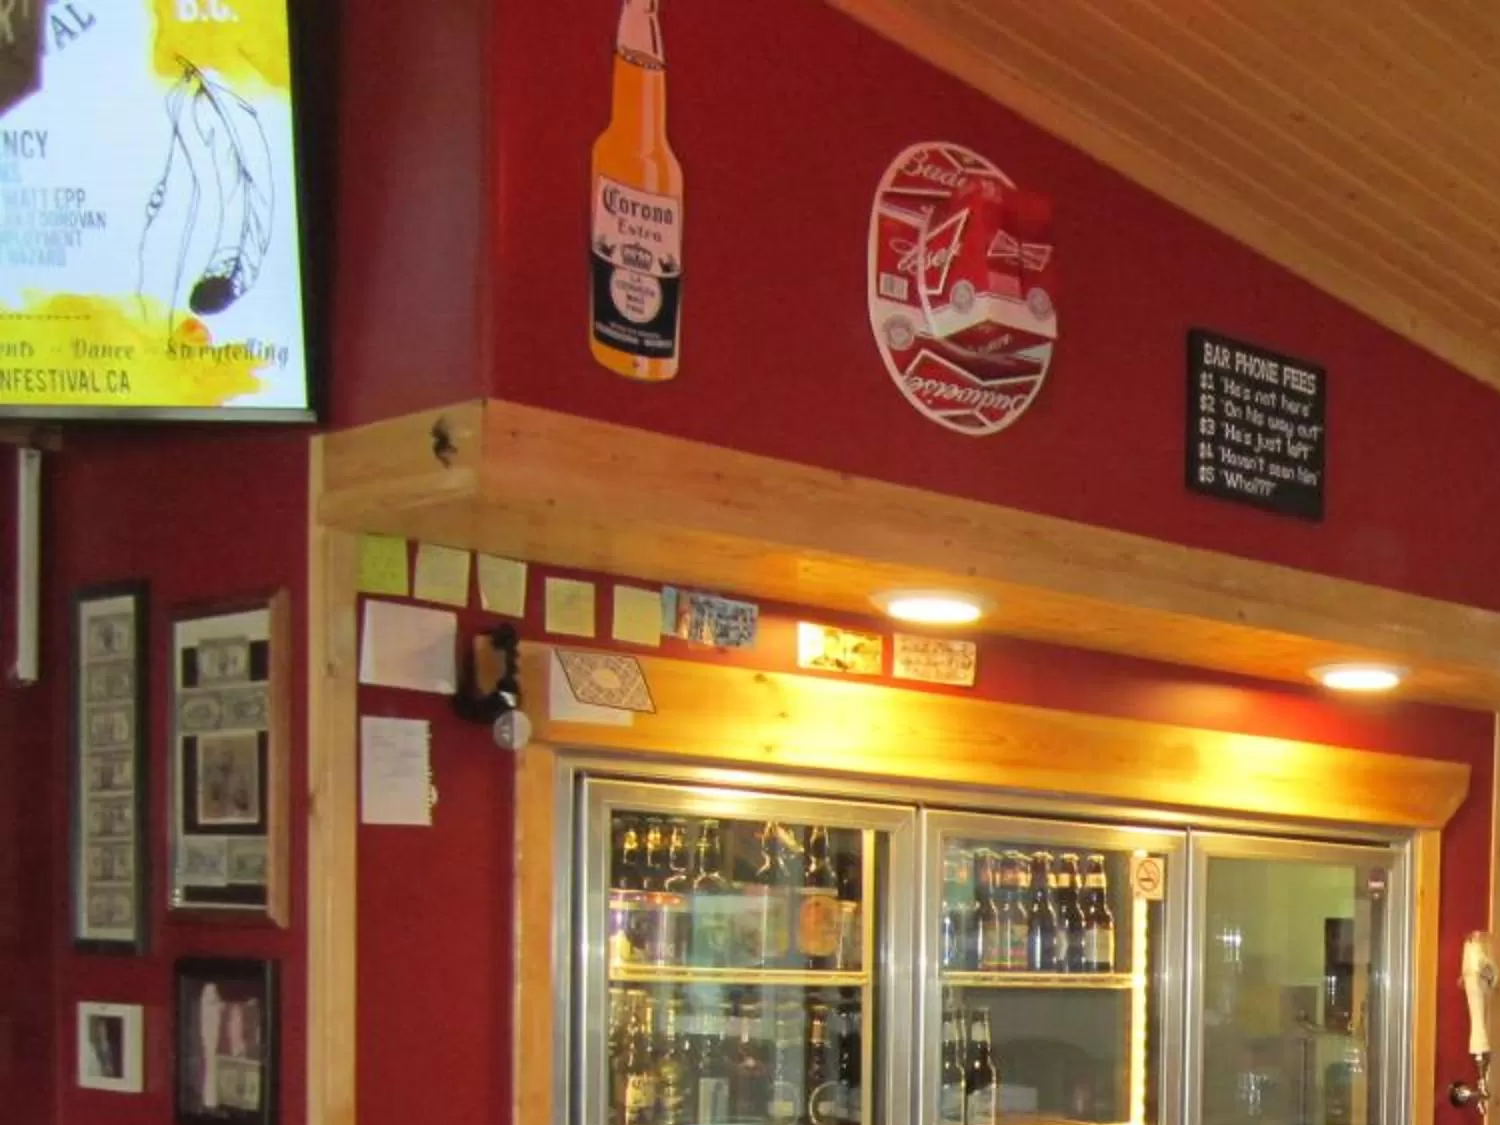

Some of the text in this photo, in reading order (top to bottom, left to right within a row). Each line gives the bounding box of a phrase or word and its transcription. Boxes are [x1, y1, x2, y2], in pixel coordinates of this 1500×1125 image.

[602, 183, 673, 225] Corona
[1203, 341, 1317, 396] BAR PHONE FEES
